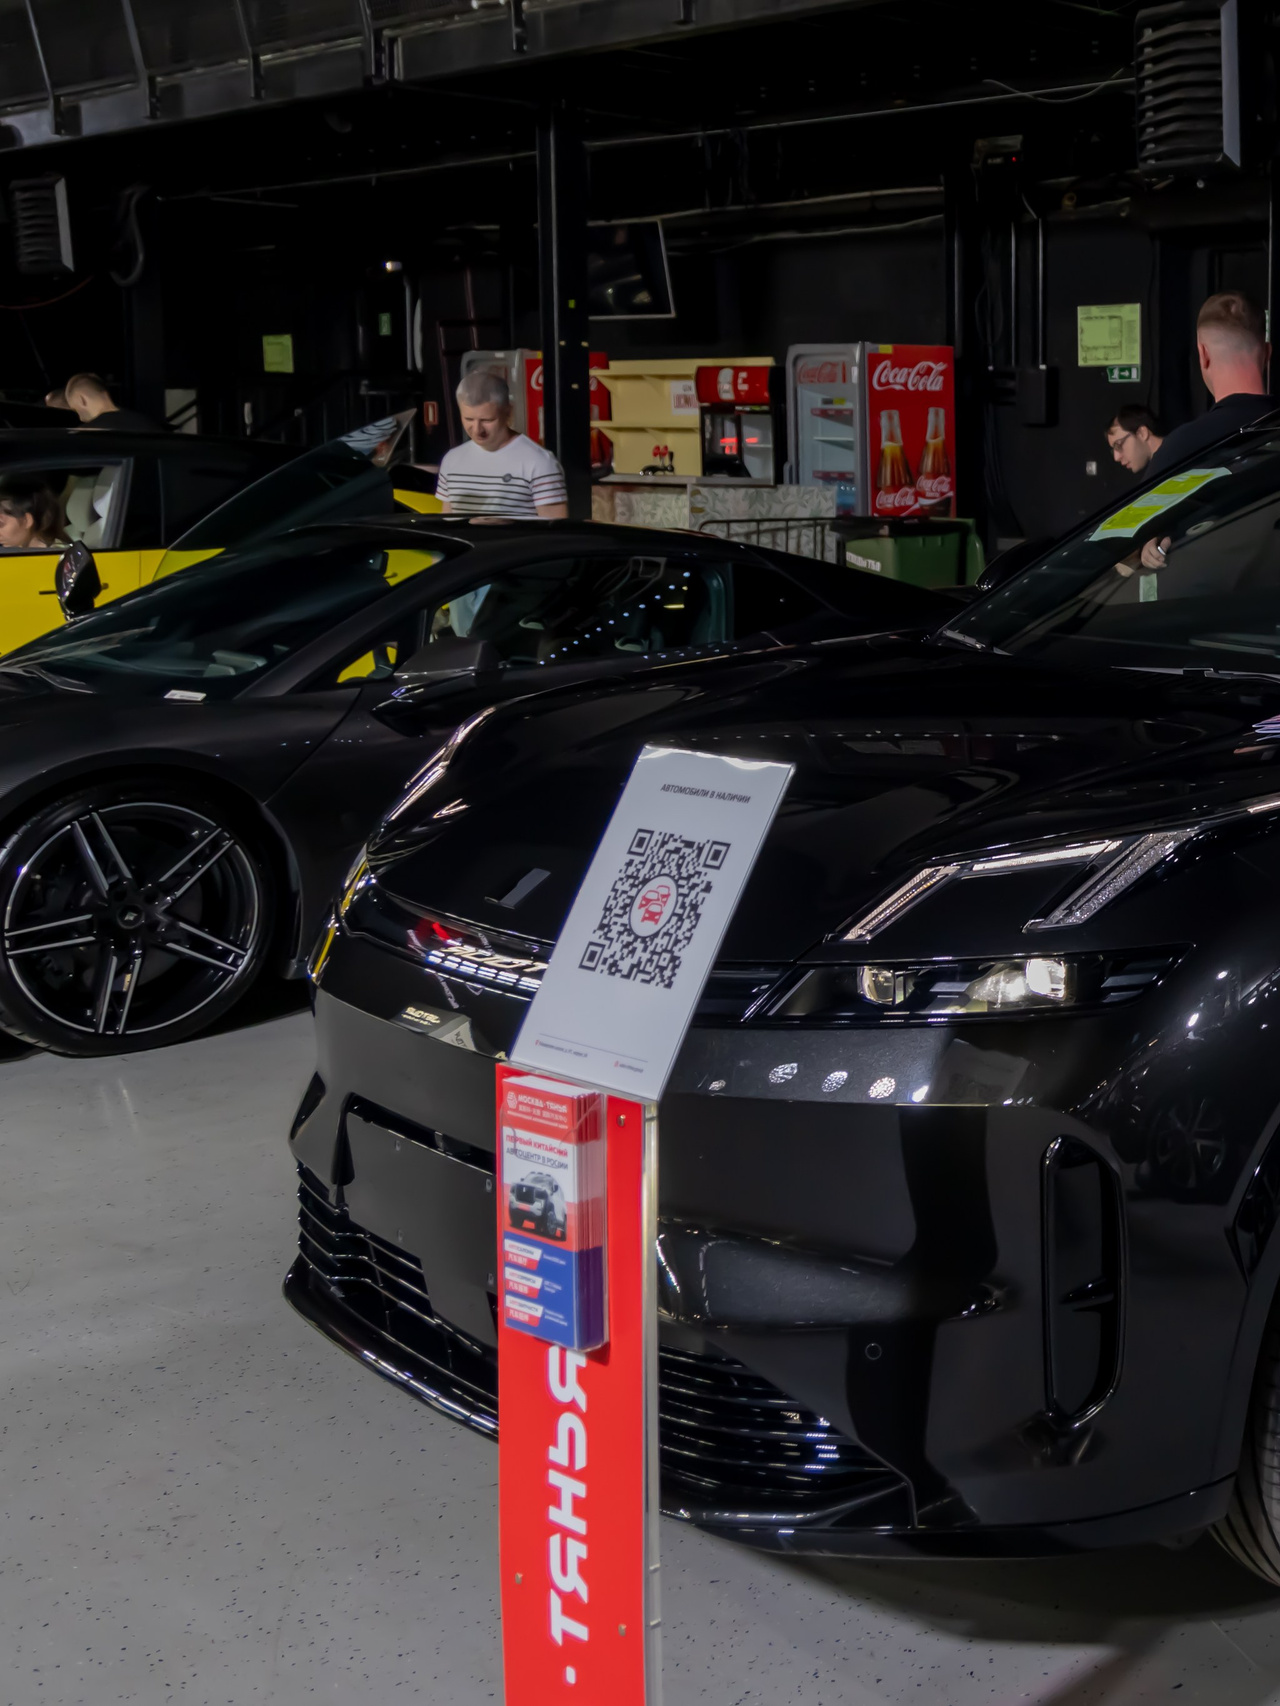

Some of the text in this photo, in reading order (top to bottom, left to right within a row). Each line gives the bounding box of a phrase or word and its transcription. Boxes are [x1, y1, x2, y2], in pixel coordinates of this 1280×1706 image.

[872, 360, 948, 391] Coca-Cola
[660, 783, 751, 804] АВТОМОБИЛИ В НАЛИЧИИ
[548, 1345, 589, 1646] ТЯНЬЯ
